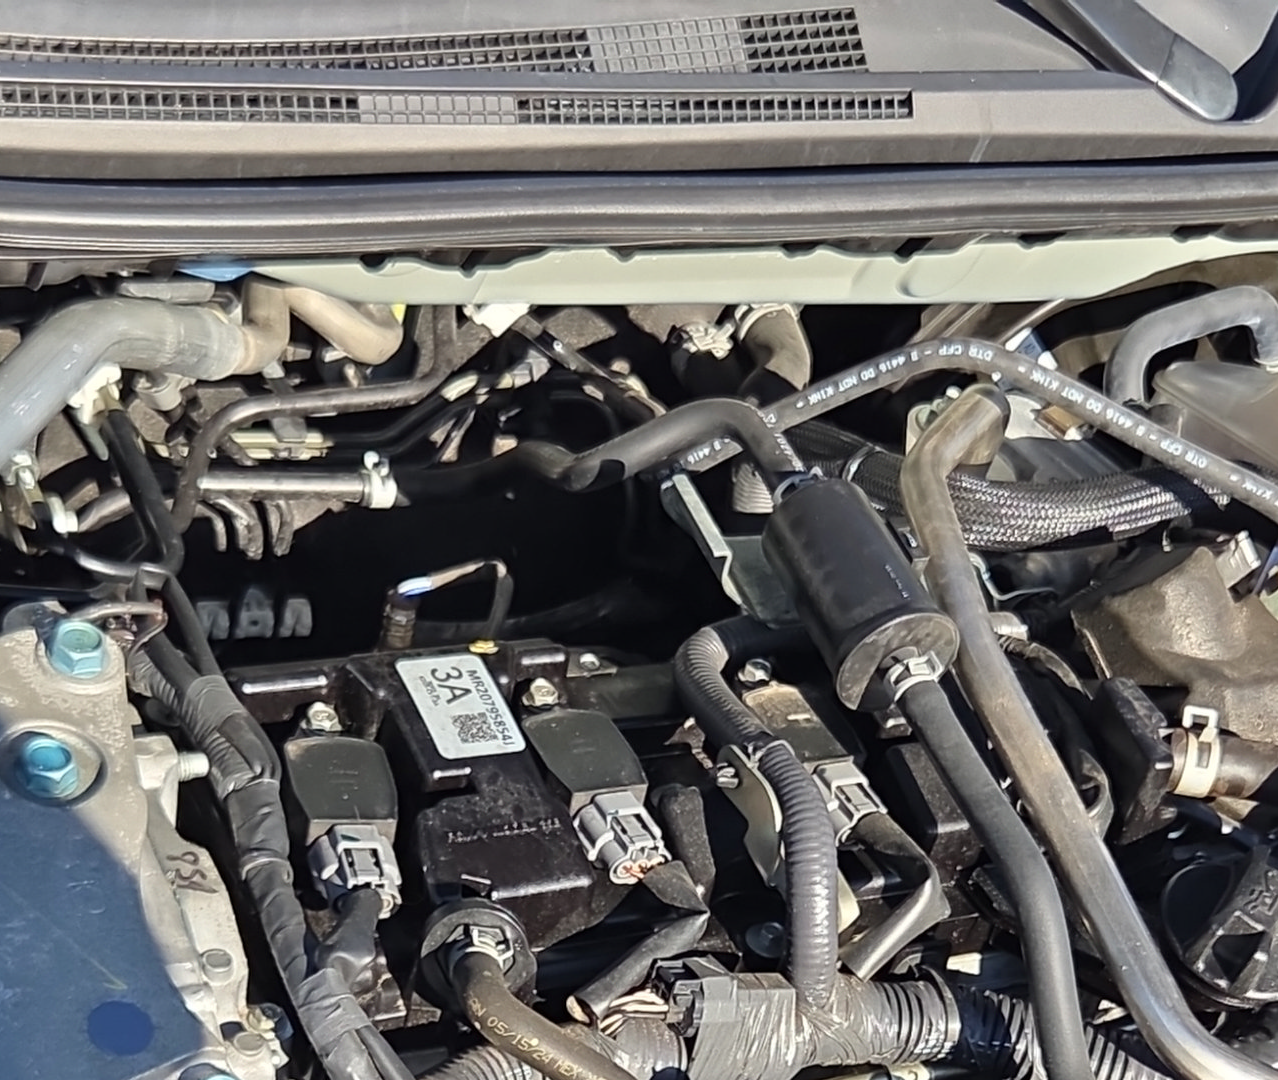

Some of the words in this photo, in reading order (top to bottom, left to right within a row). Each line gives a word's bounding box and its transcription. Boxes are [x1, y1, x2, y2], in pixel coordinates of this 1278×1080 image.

[939, 344, 961, 355] CFP
[878, 354, 905, 372] 4416
[836, 375, 857, 392] NOT
[1028, 368, 1058, 391] KINK
[807, 385, 833, 404] KINK
[1060, 384, 1084, 403] NOT
[1103, 408, 1133, 430] 4416
[1158, 436, 1183, 455] CFP
[429, 658, 473, 705] 3A
[485, 1015, 552, 1066] 05/15/24
